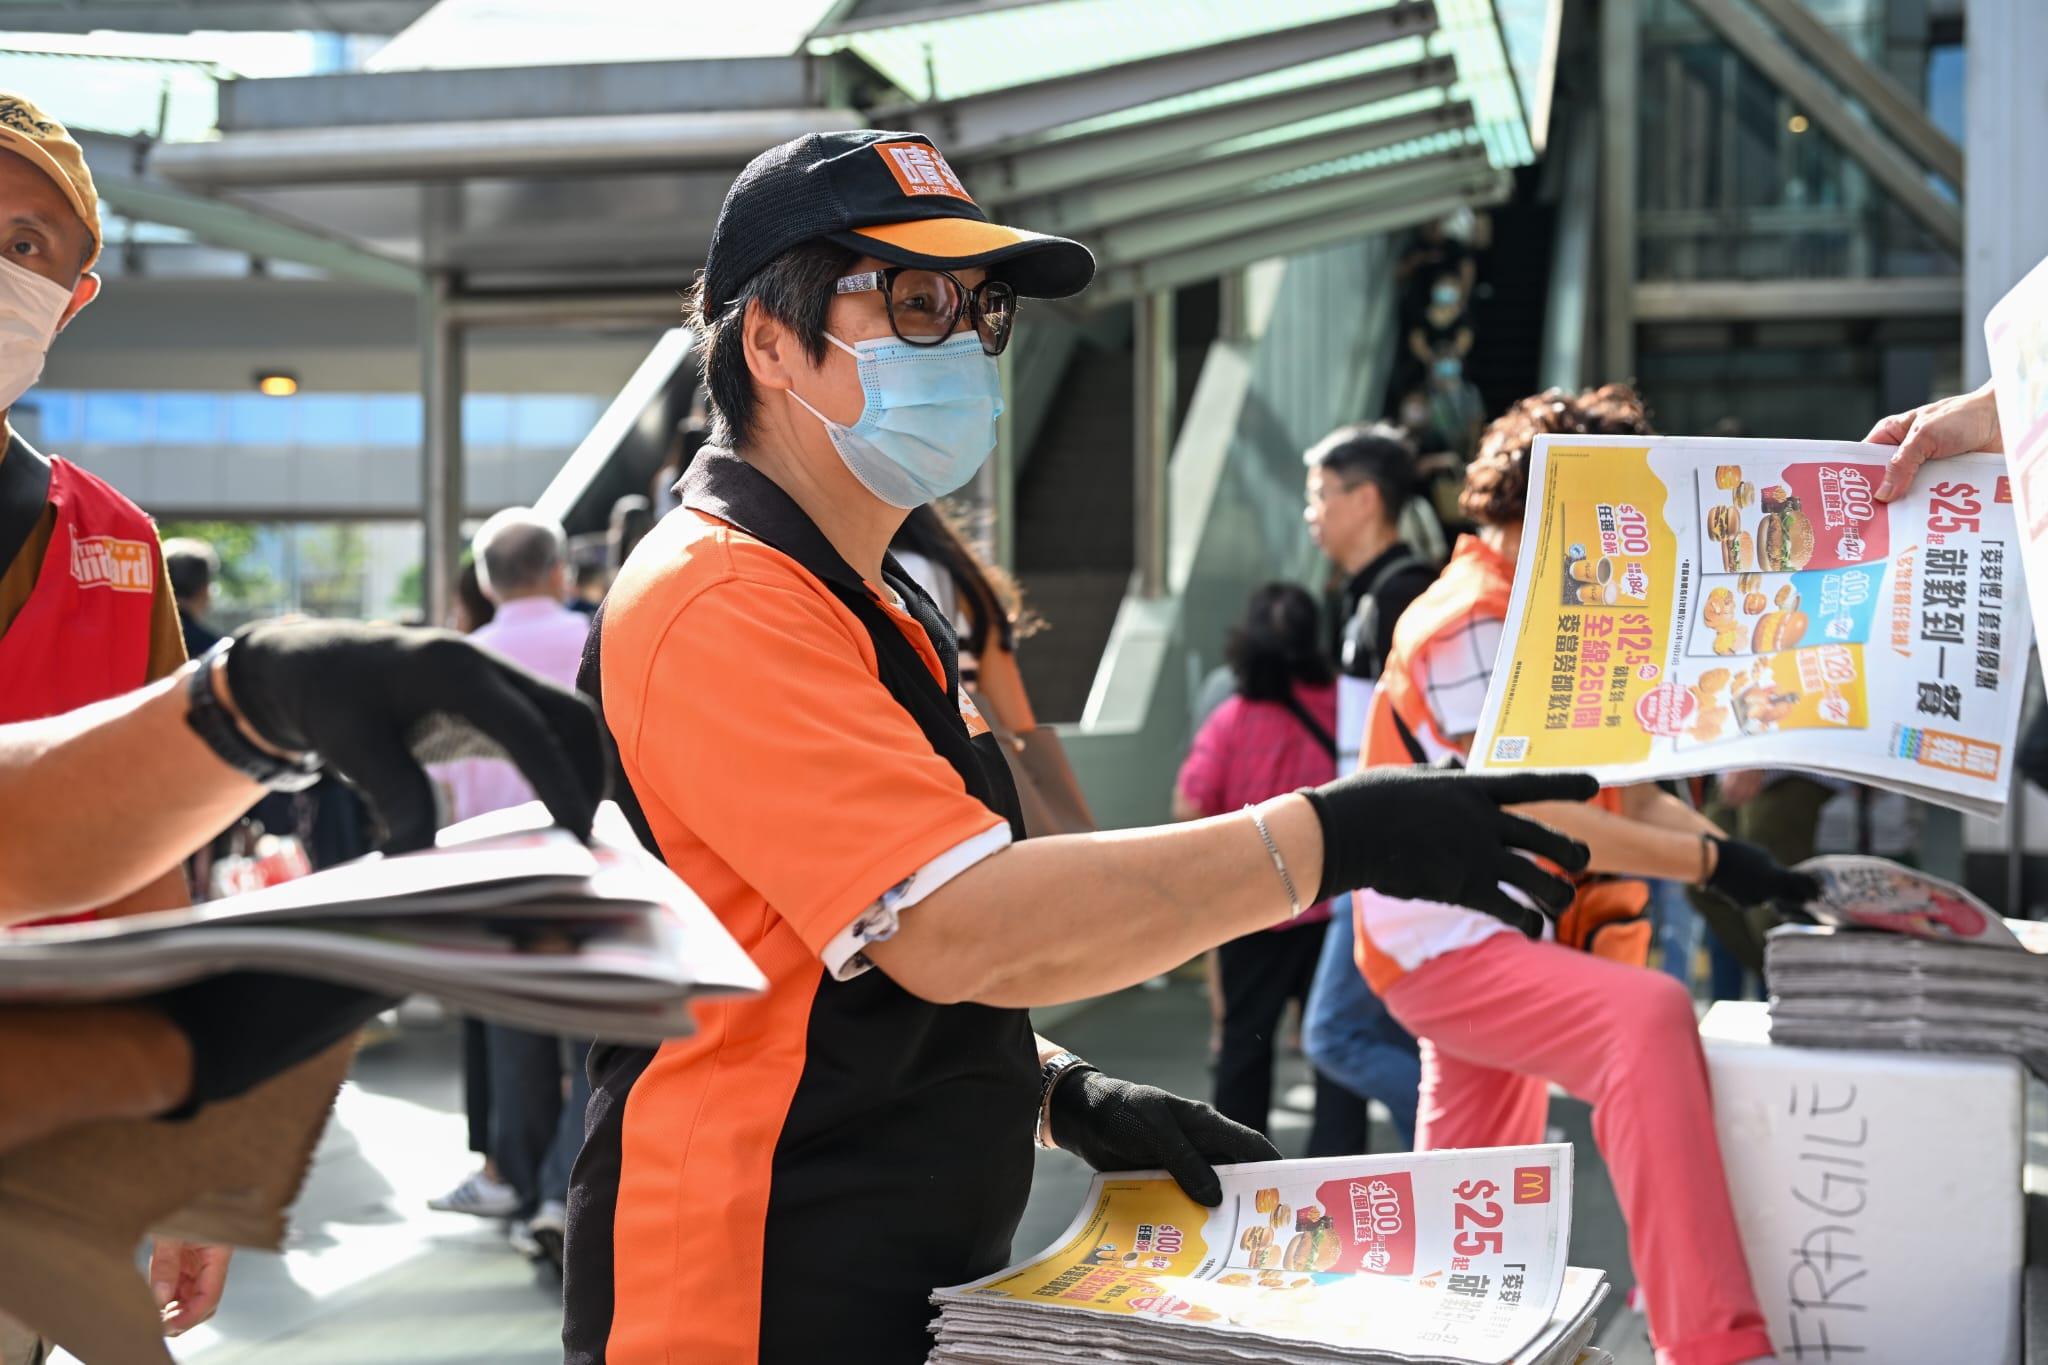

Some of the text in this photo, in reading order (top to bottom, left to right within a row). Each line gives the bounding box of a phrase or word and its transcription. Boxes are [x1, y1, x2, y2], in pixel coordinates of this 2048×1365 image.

[1842, 468, 1872, 519] $100
[1598, 504, 1619, 555] 任選8杯
[1619, 504, 1649, 553] $100
[1617, 613, 1653, 665] $12.5
[1571, 614, 1614, 729] 全線250間
[1371, 1181, 1402, 1235] $100
[1782, 1082, 1868, 1363] FRAGILE
[1155, 1224, 1183, 1254] $100
